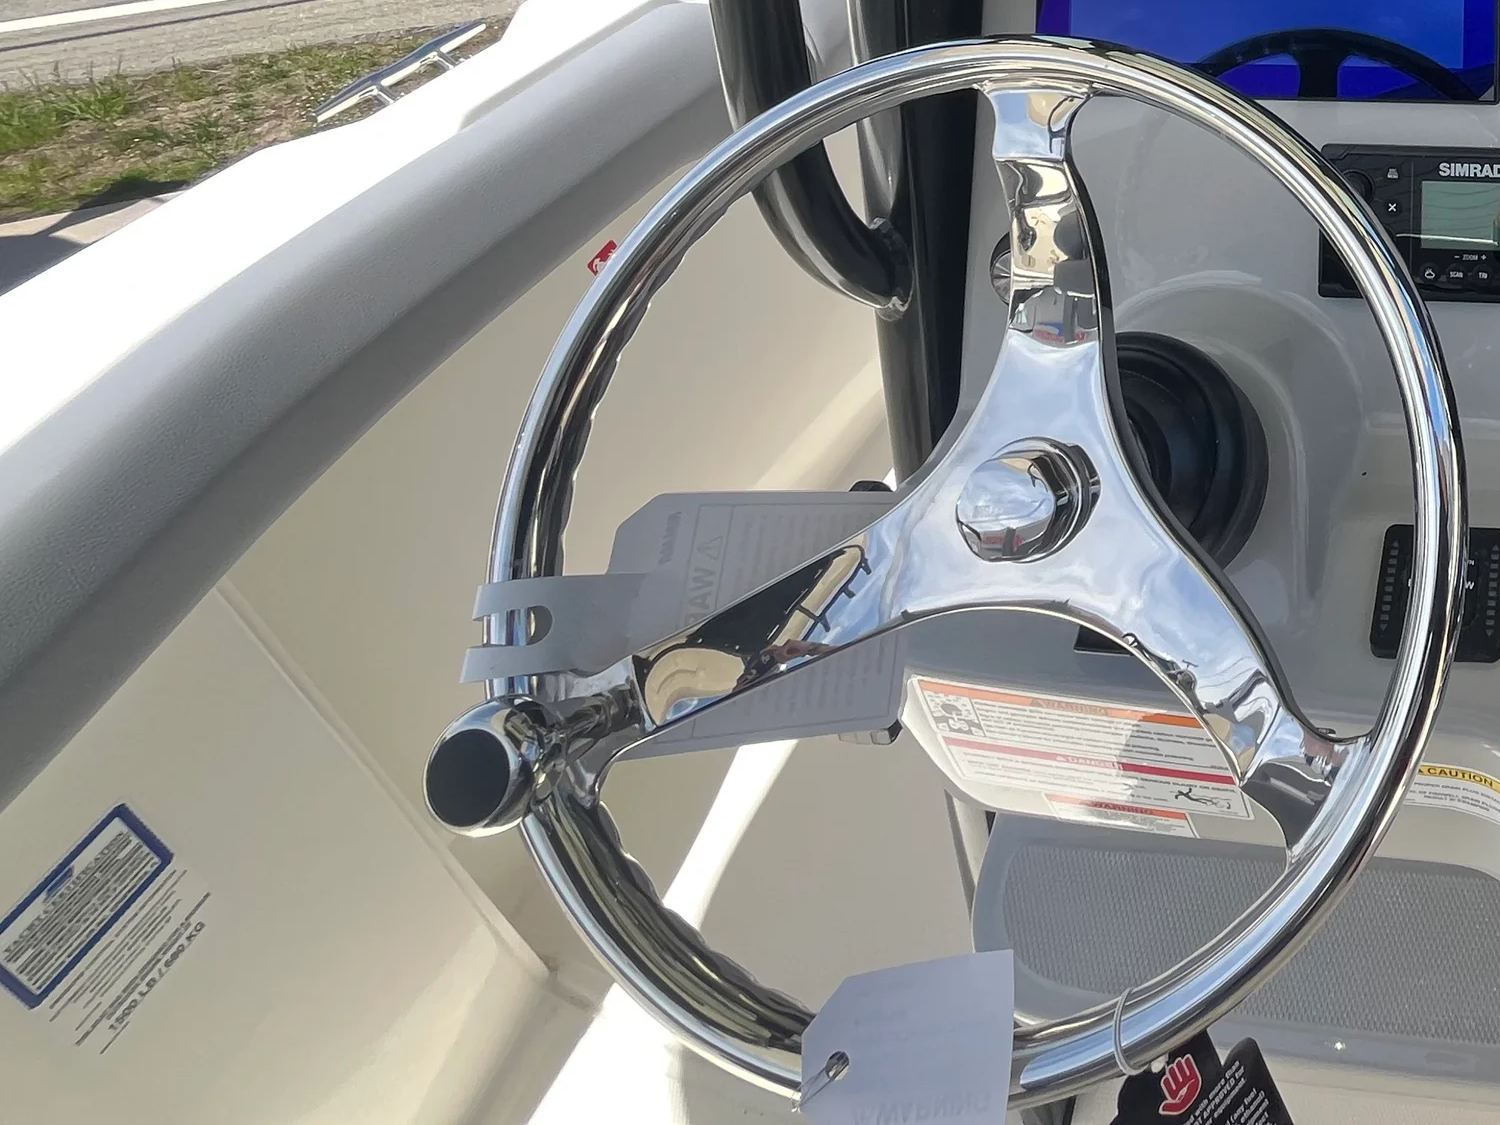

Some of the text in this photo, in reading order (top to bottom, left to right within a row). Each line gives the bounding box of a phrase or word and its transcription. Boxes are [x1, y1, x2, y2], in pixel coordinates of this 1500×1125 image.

[1427, 767, 1494, 788] CAUTION
[186, 921, 206, 942] KG
[1203, 1077, 1235, 1119] APPROVED
